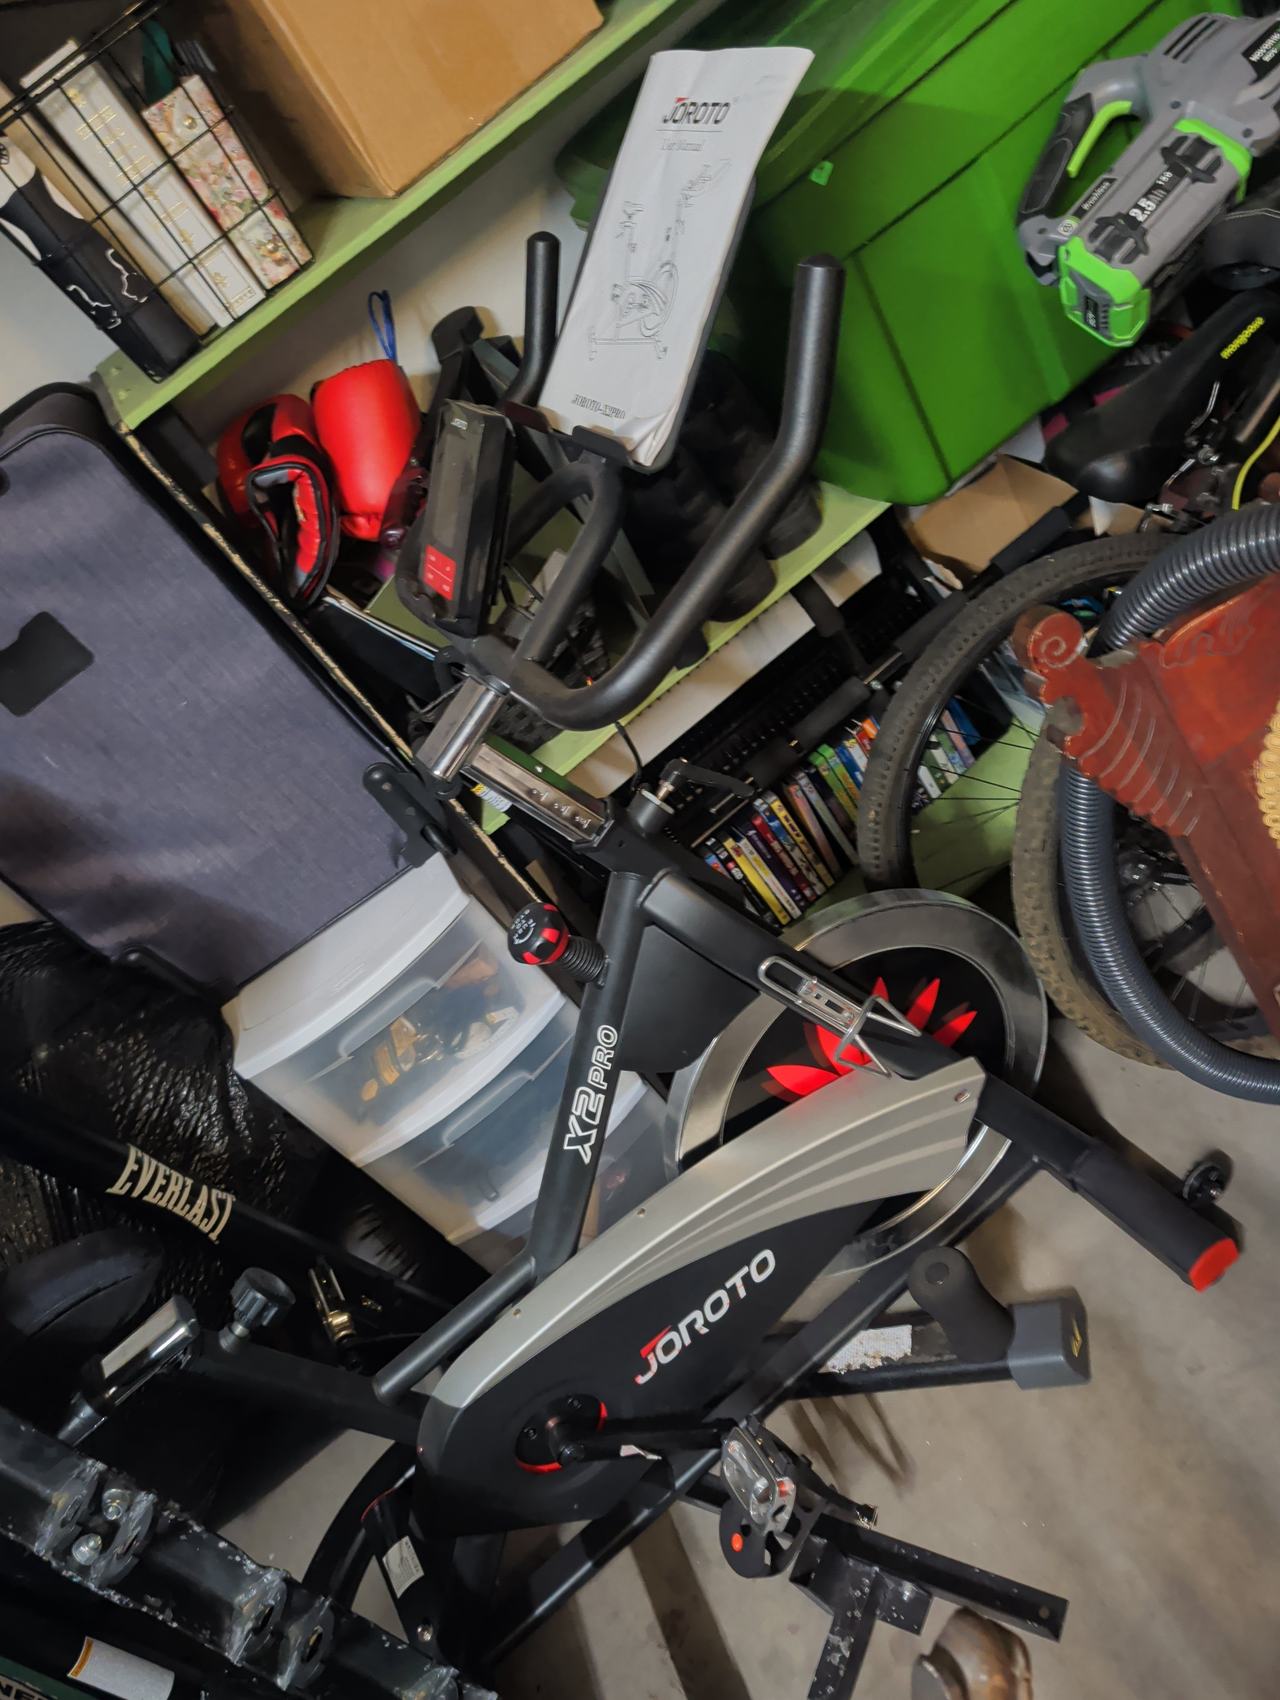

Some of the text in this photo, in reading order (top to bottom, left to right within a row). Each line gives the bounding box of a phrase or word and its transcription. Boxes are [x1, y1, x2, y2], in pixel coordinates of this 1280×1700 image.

[663, 97, 731, 124] JOROTO
[1220, 316, 1265, 359] mongoose
[563, 1024, 618, 1165] X2 PRO
[104, 1142, 236, 1241] EVERLAST
[634, 1249, 776, 1385] JOROTO
